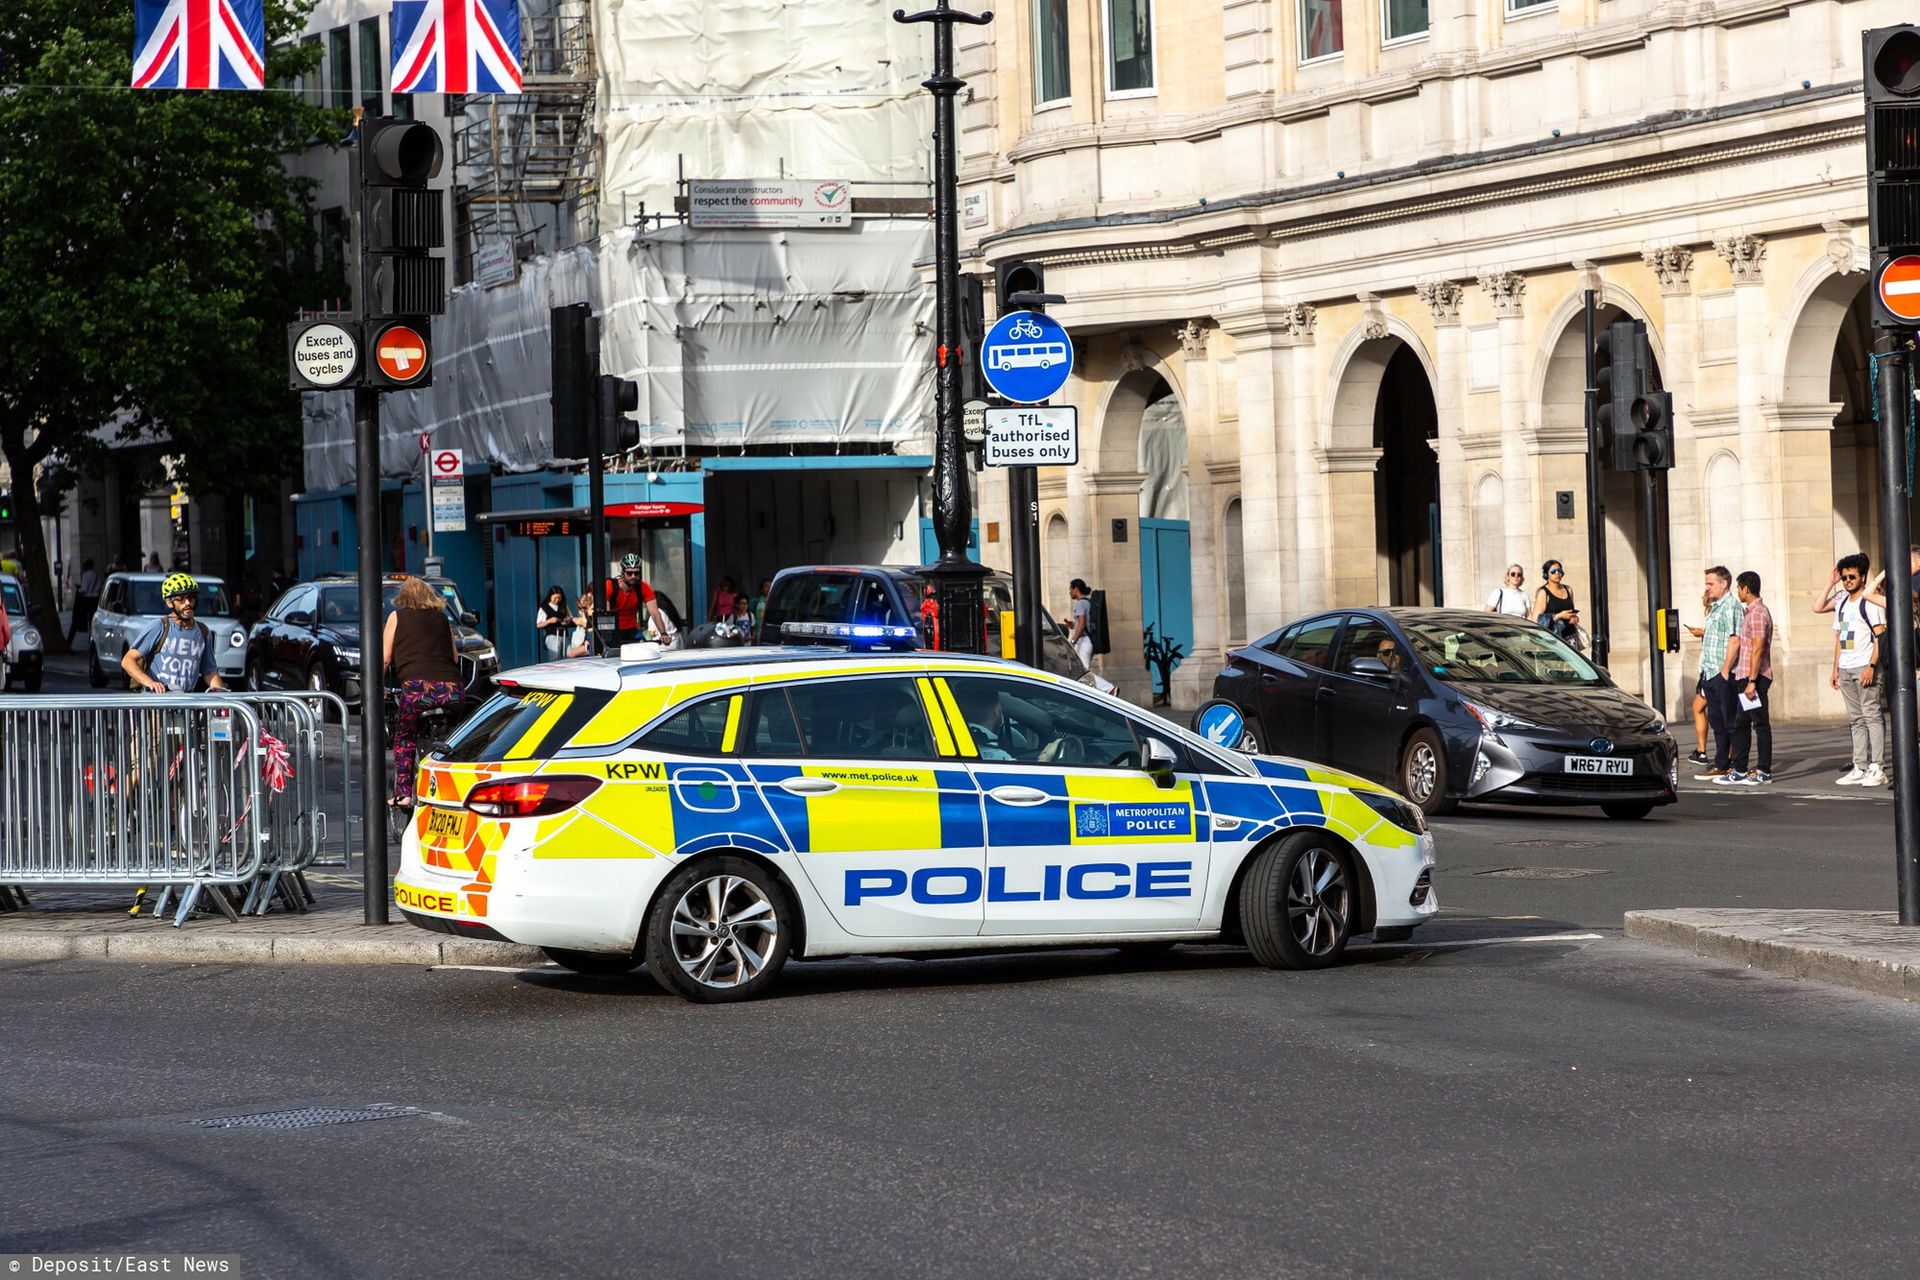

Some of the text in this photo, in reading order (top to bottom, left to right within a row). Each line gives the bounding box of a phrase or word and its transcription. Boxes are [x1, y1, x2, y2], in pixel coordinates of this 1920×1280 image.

[694, 185, 783, 194] Considerate constructors
[694, 195, 803, 207] respect the community
[306, 335, 343, 347] Except
[298, 348, 353, 361] buses and
[309, 363, 343, 377] cycles
[1018, 414, 1043, 426] TfL
[965, 426, 985, 435] cycle
[991, 429, 1070, 442] authorised
[422, 434, 429, 448] K
[992, 445, 1070, 459] buses only
[160, 637, 205, 656] NEW
[518, 691, 558, 707] KPW
[606, 764, 660, 778] KPW
[1571, 758, 1628, 773] WR67 RYU
[821, 771, 919, 782] www.met.police.uk
[1115, 808, 1184, 817] METROPOLITAN
[1126, 820, 1176, 830] POLICE
[844, 861, 1192, 906] POLICE
[394, 886, 453, 912] POLICE
